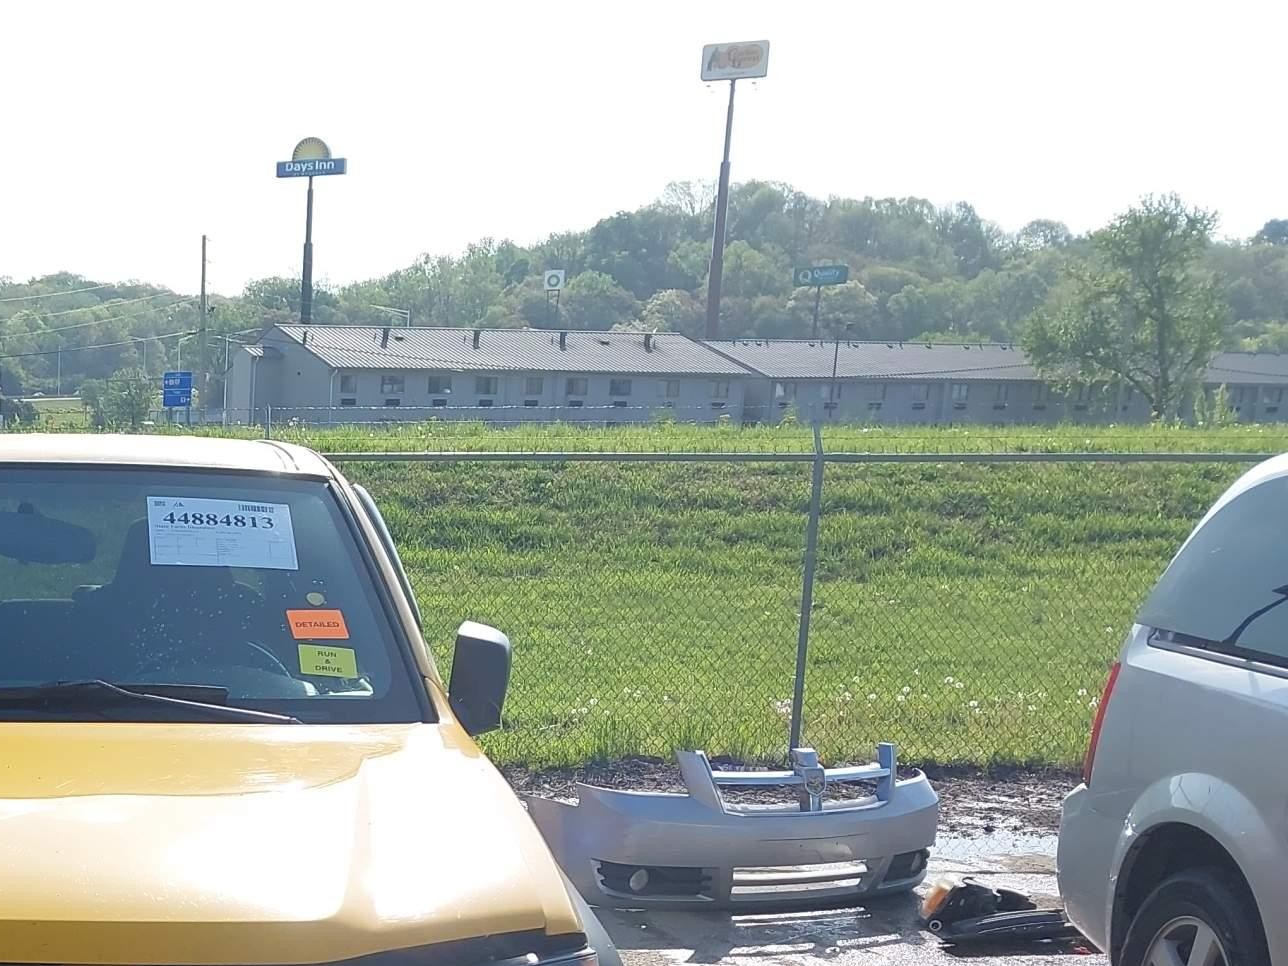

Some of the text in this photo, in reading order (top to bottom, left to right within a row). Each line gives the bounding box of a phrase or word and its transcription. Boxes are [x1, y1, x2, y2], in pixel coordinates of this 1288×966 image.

[285, 160, 335, 172] Days Inn
[162, 511, 274, 530] 44884813
[316, 650, 337, 658] RUN
[314, 665, 343, 673] DRIVE
